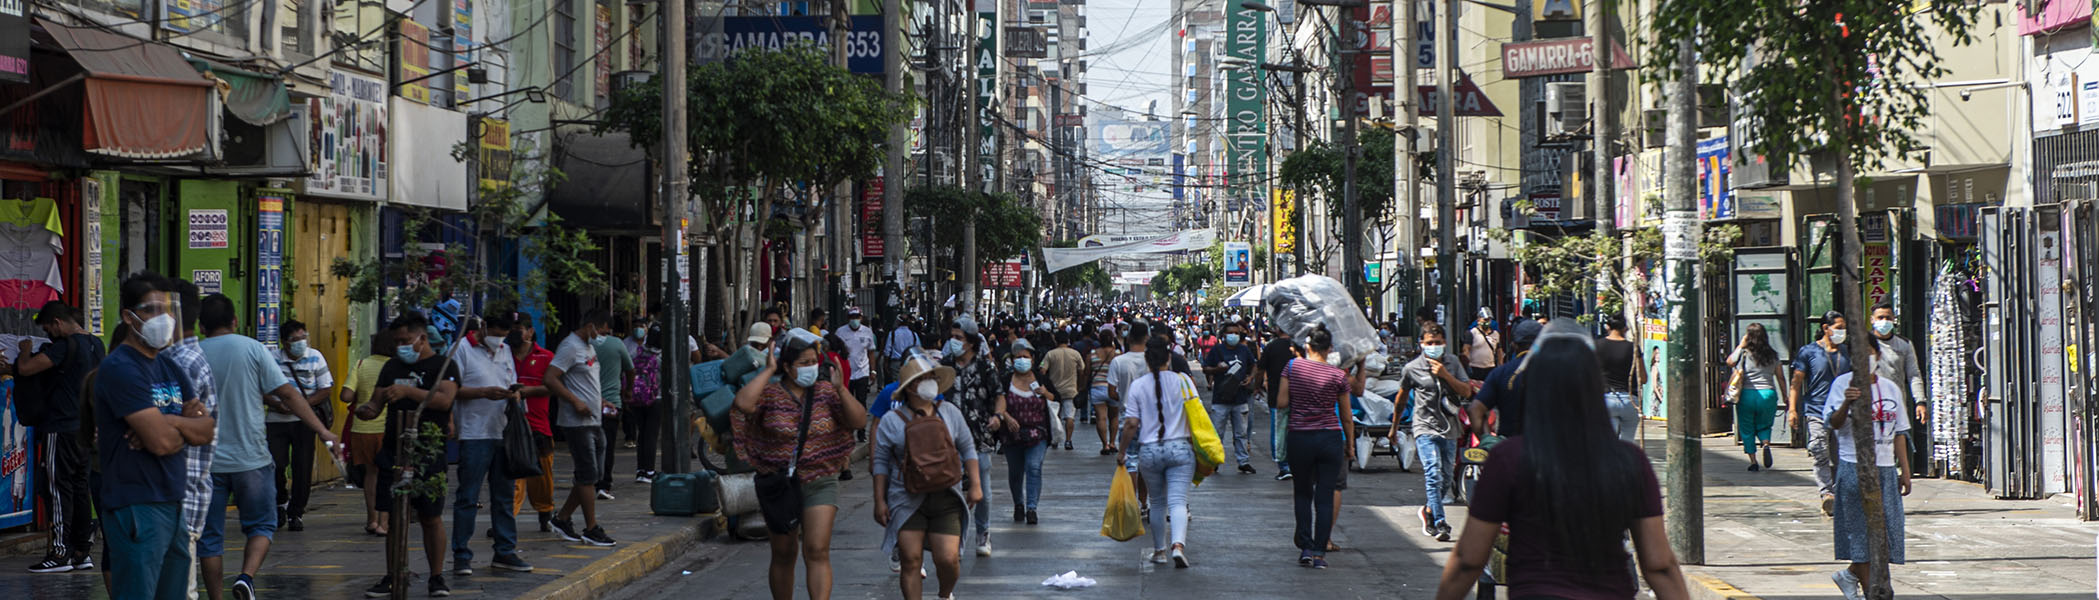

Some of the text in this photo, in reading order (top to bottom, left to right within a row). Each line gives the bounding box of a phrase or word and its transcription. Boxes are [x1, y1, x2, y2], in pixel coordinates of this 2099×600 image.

[846, 31, 880, 58] 653
[1236, 110, 1258, 179] ENTRO
[194, 271, 220, 282] AFORO
